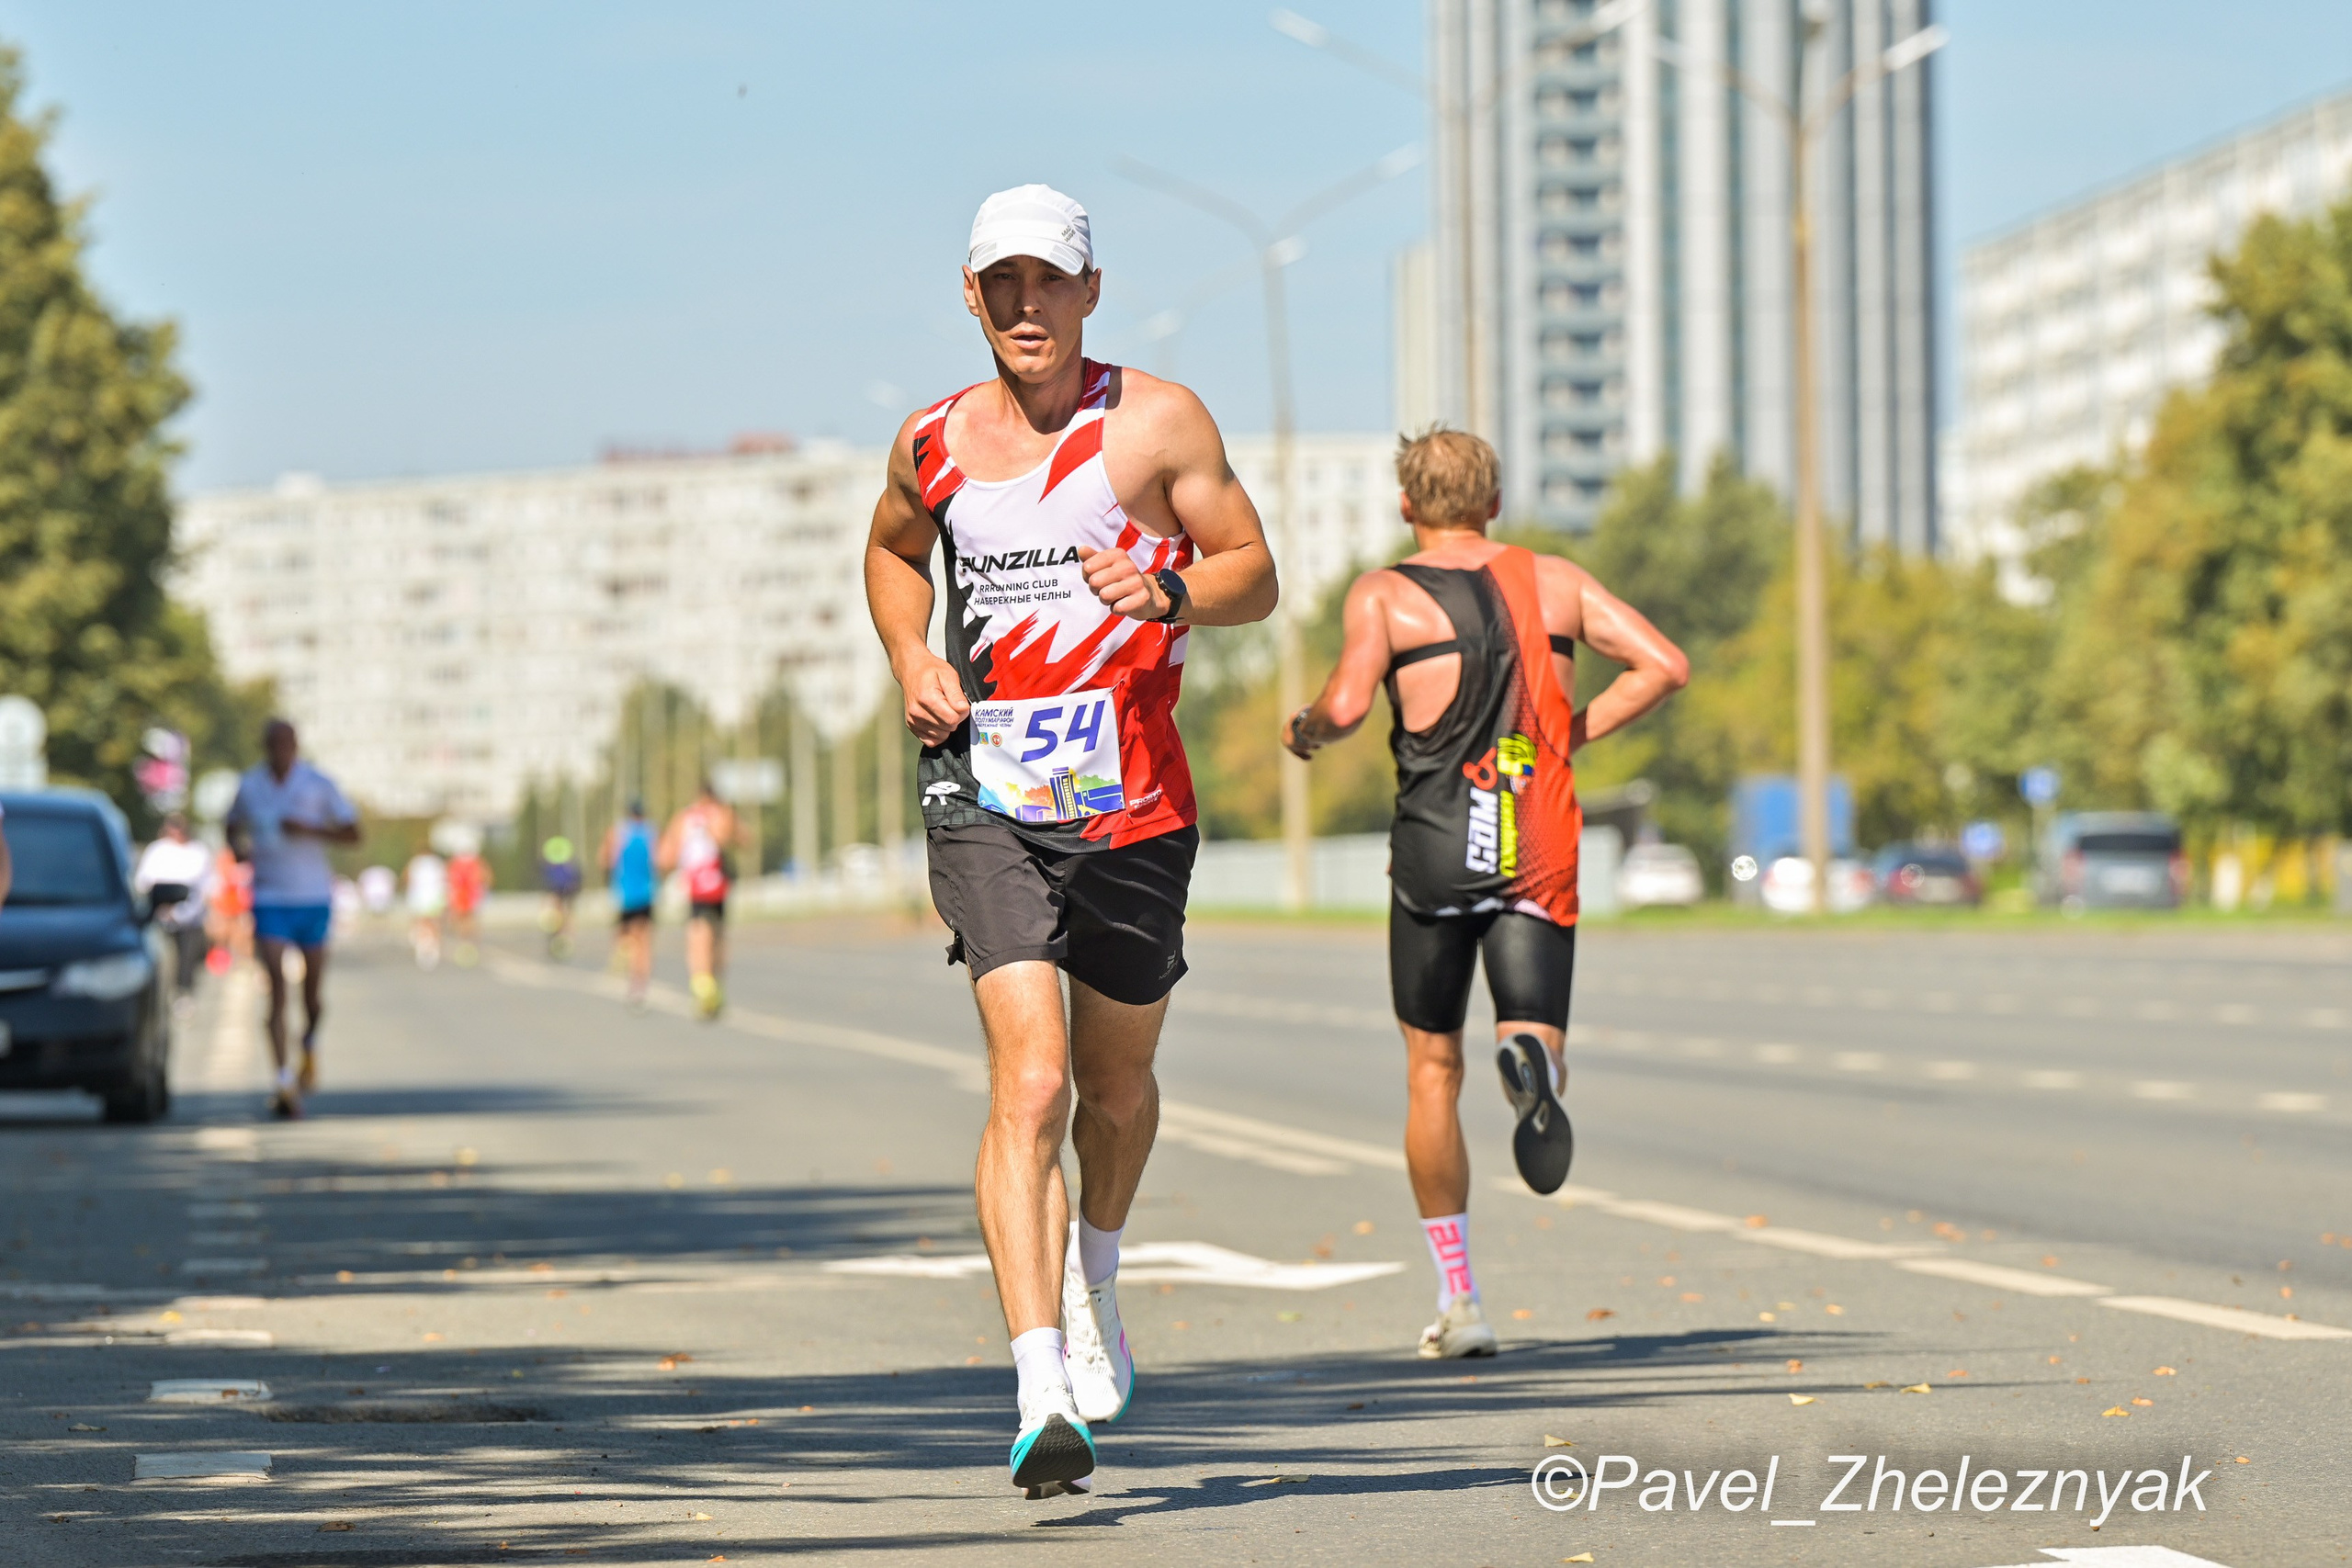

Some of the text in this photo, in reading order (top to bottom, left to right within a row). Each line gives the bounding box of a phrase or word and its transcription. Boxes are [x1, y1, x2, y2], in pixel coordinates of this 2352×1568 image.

[1032, 579, 1058, 591] CLUB
[1034, 591, 1071, 603] ЧЕЛНЫ
[975, 706, 1014, 717] КАМСКИЙ
[1021, 700, 1106, 763] 54
